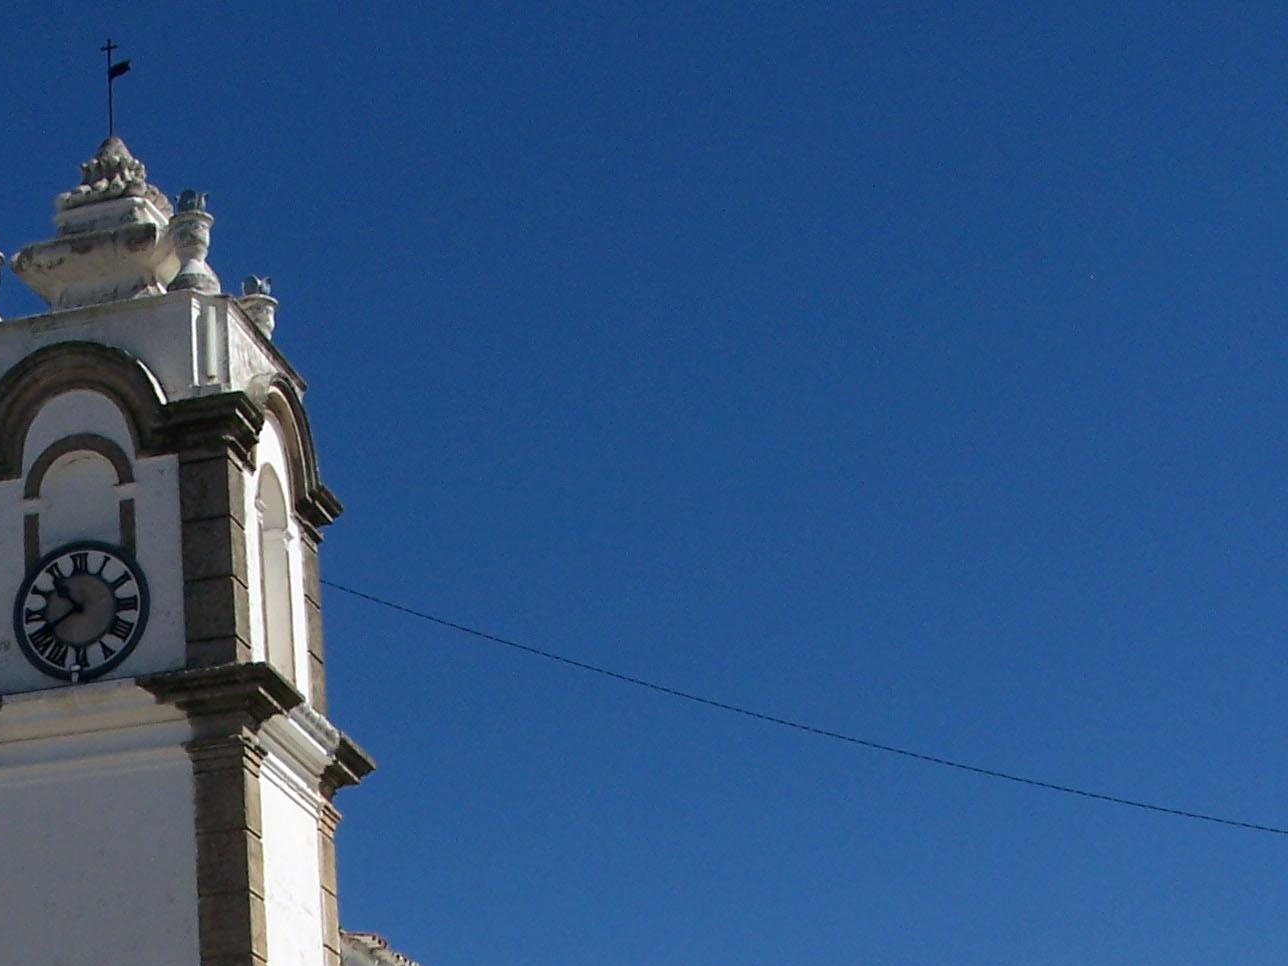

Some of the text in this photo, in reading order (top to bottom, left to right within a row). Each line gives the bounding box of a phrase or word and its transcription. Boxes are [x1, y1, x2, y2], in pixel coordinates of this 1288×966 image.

[97, 556, 110, 575] I
[112, 571, 131, 590] II
[116, 596, 138, 612] III
[99, 641, 116, 660] V
